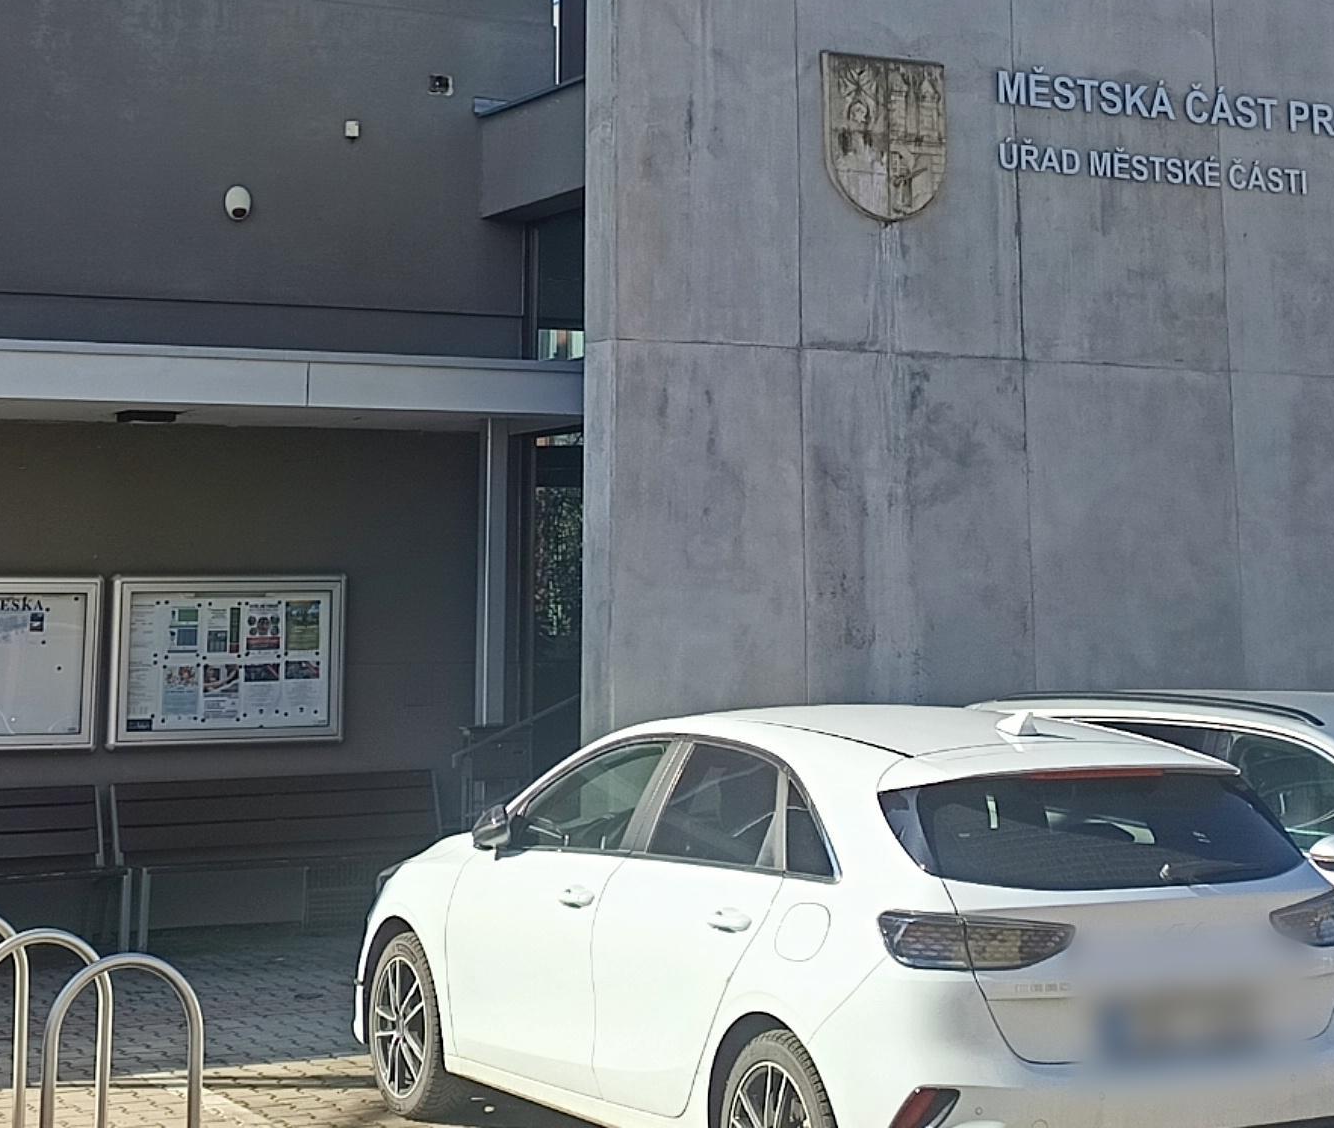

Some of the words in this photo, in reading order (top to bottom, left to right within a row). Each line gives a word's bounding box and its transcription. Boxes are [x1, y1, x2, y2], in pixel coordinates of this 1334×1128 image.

[997, 66, 1176, 120] MĚSTSKÁ
[1185, 83, 1278, 130] ČÁST
[999, 138, 1081, 175] ÚŘAD
[1089, 147, 1221, 188] MĚSTSKÉ
[1228, 158, 1308, 195] ČÁSTI
